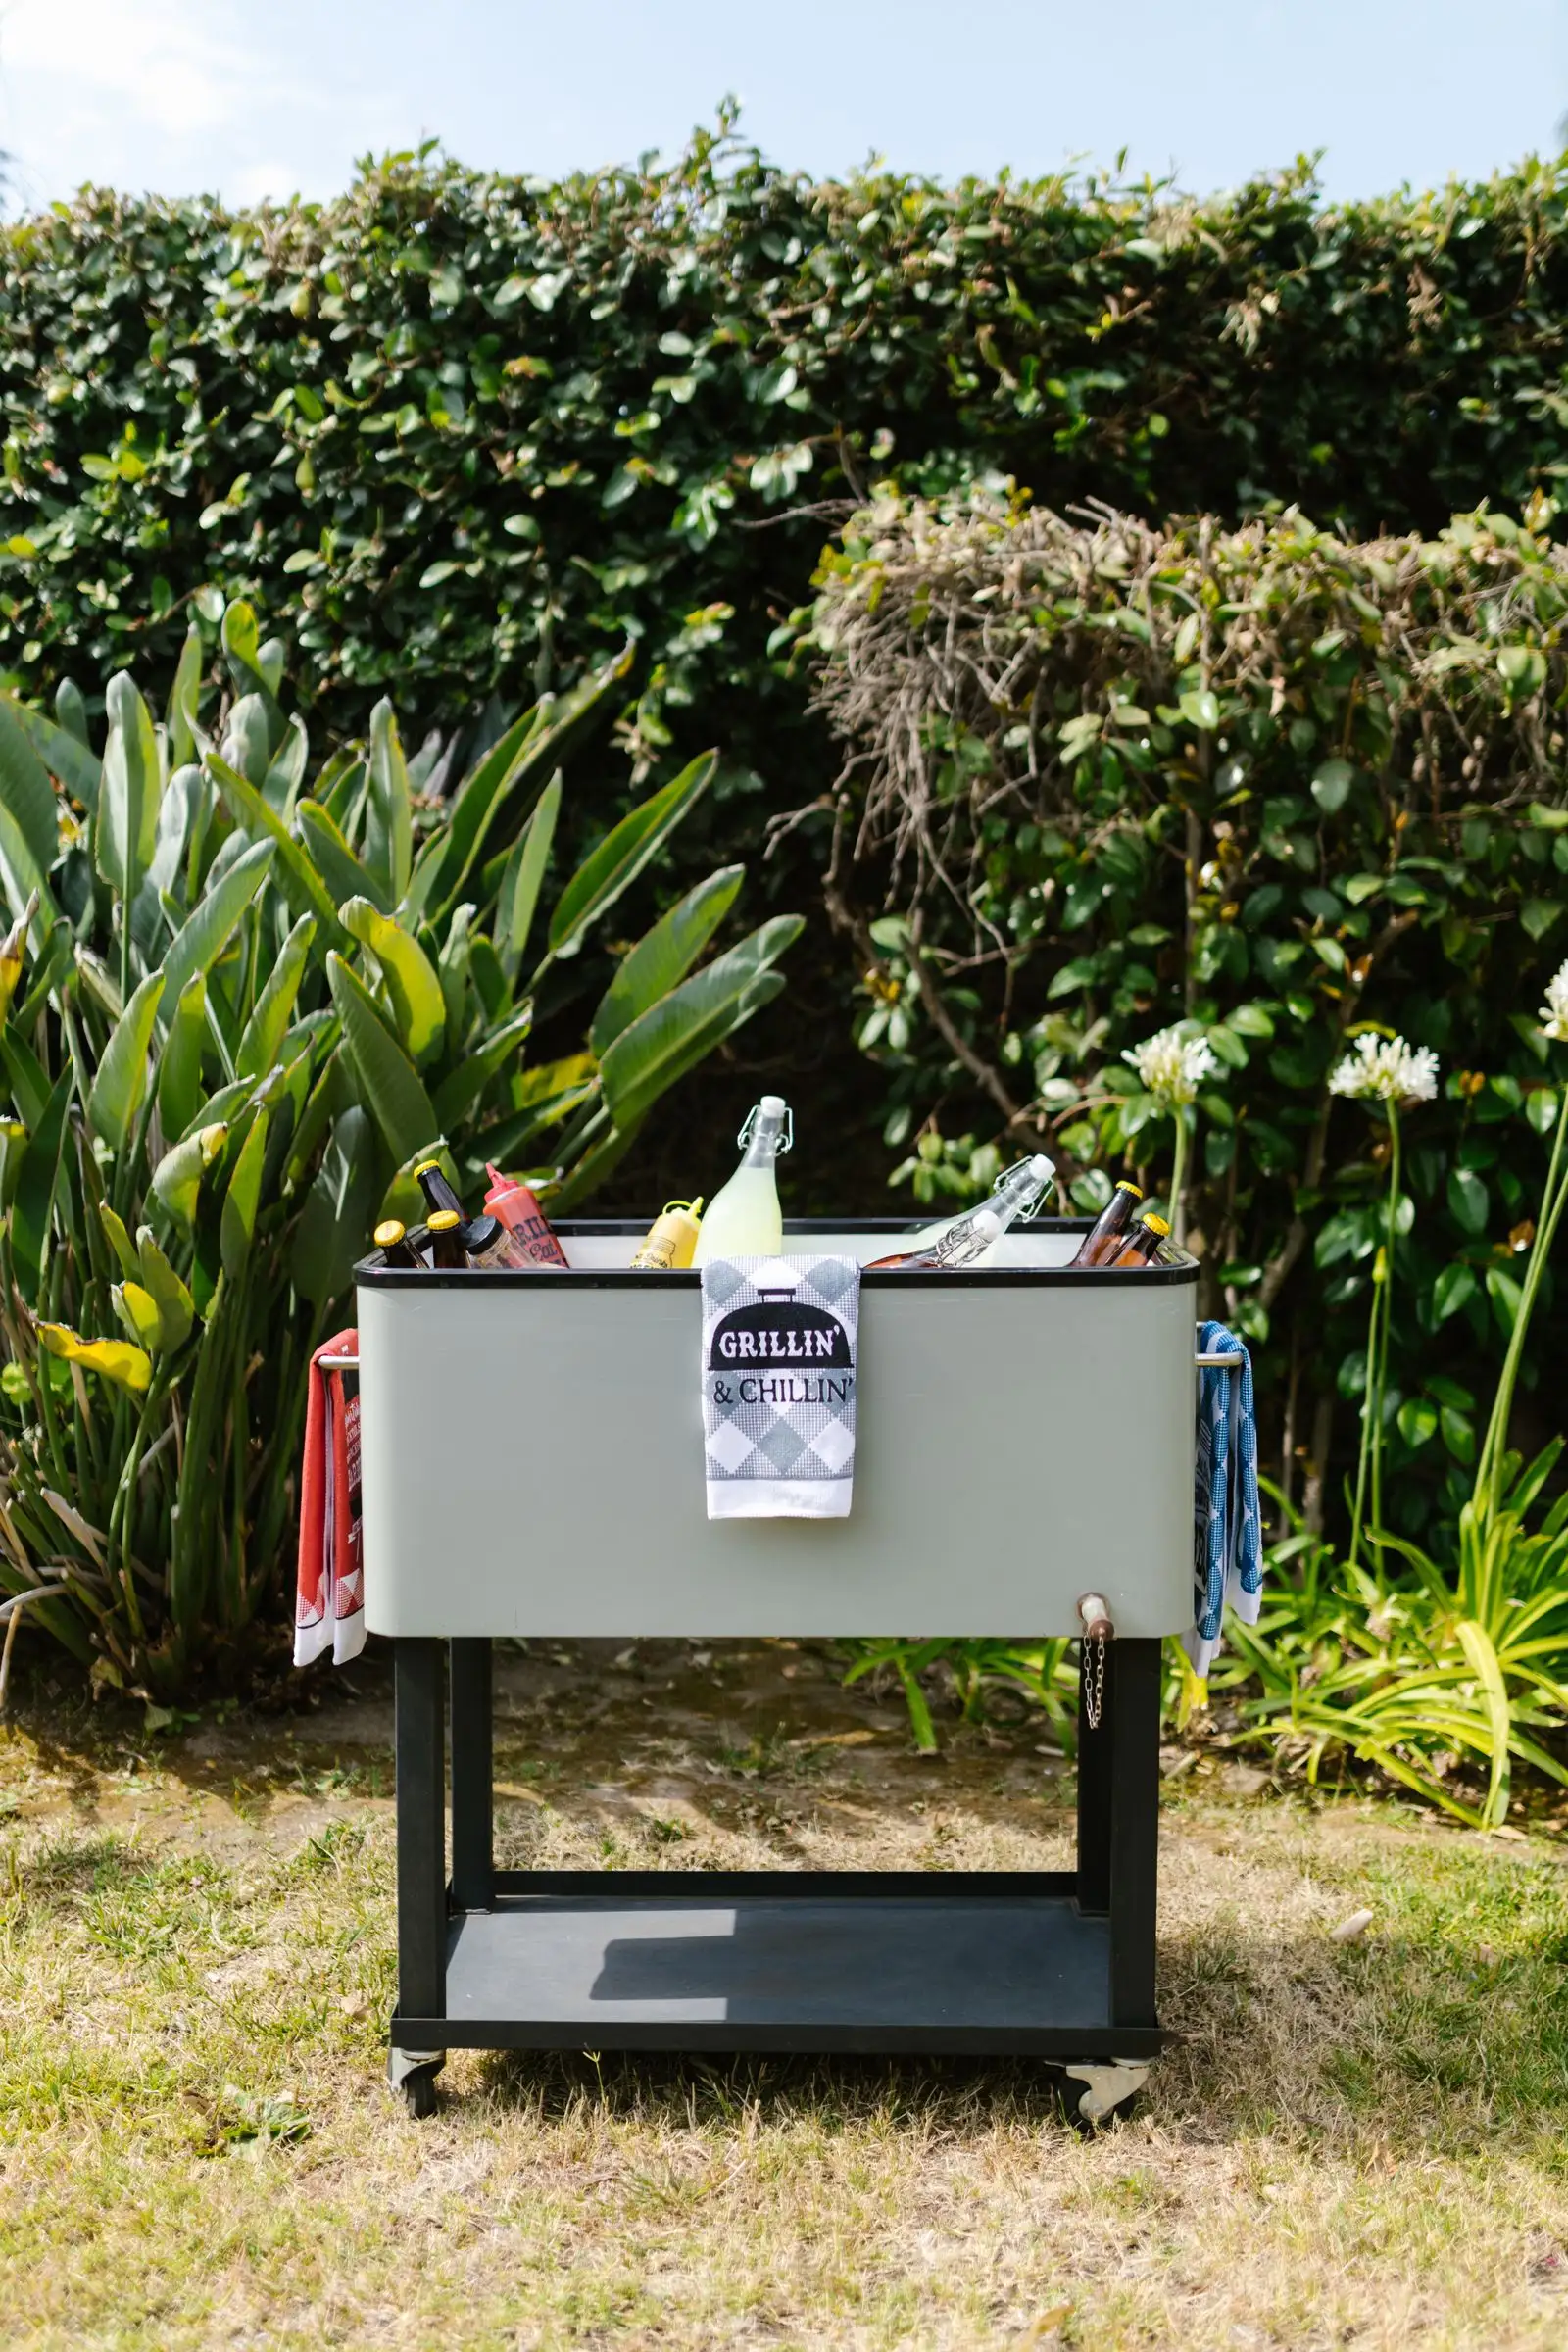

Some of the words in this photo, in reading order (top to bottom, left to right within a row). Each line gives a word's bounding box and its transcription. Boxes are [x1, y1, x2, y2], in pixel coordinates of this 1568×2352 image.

[718, 1324, 840, 1358] GRILLIN'
[713, 1380, 733, 1404] &
[739, 1378, 854, 1404] CHILLIN'
